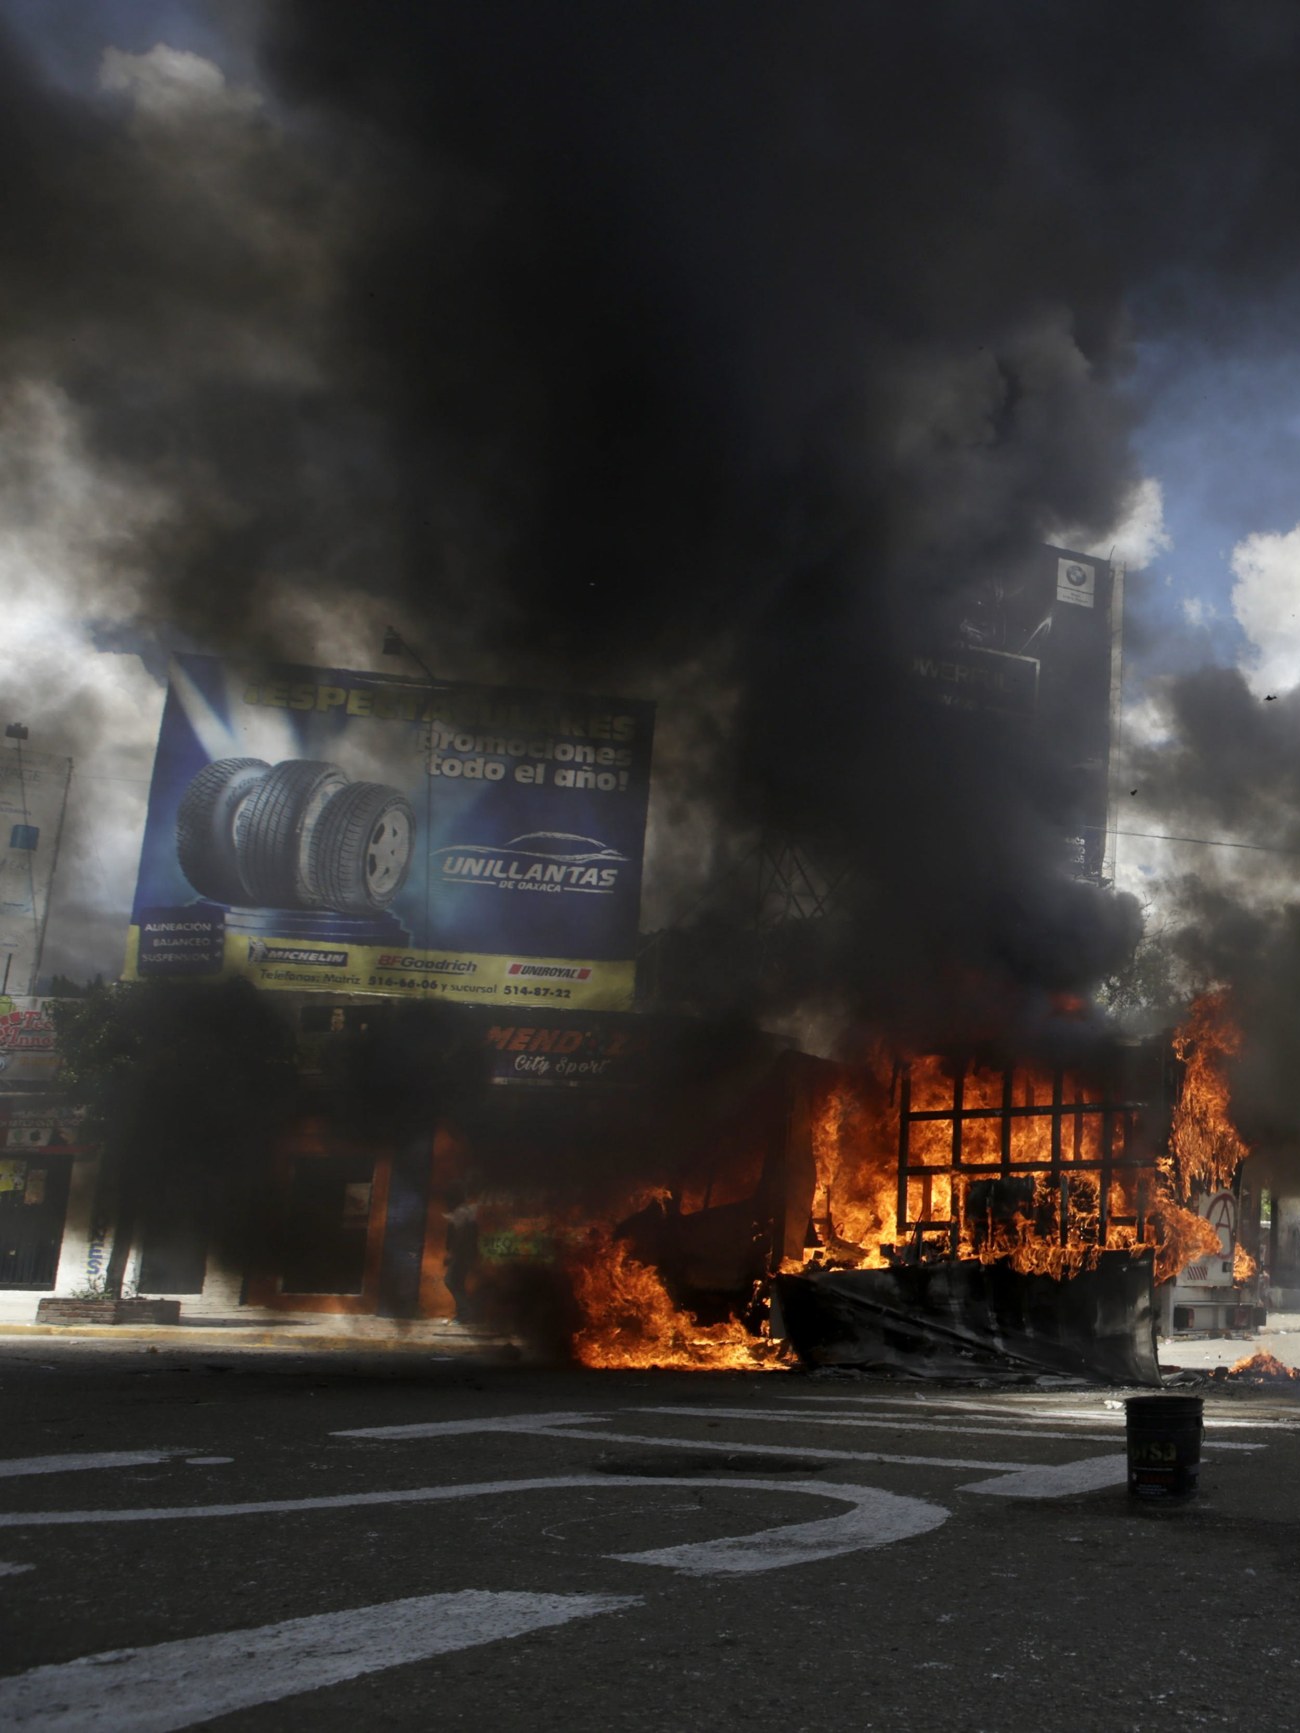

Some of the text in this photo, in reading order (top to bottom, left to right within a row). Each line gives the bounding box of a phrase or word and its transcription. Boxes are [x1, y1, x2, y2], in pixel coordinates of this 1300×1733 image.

[417, 725, 633, 768] promociones
[430, 754, 629, 792] todo el año!
[441, 855, 618, 888] UNILLANTAS
[499, 880, 562, 894] DE OAXACA
[267, 949, 345, 964] MICHELIN
[323, 973, 361, 986] Matriz
[503, 985, 572, 1000] 514-87-22
[513, 1053, 612, 1077] City Sport
